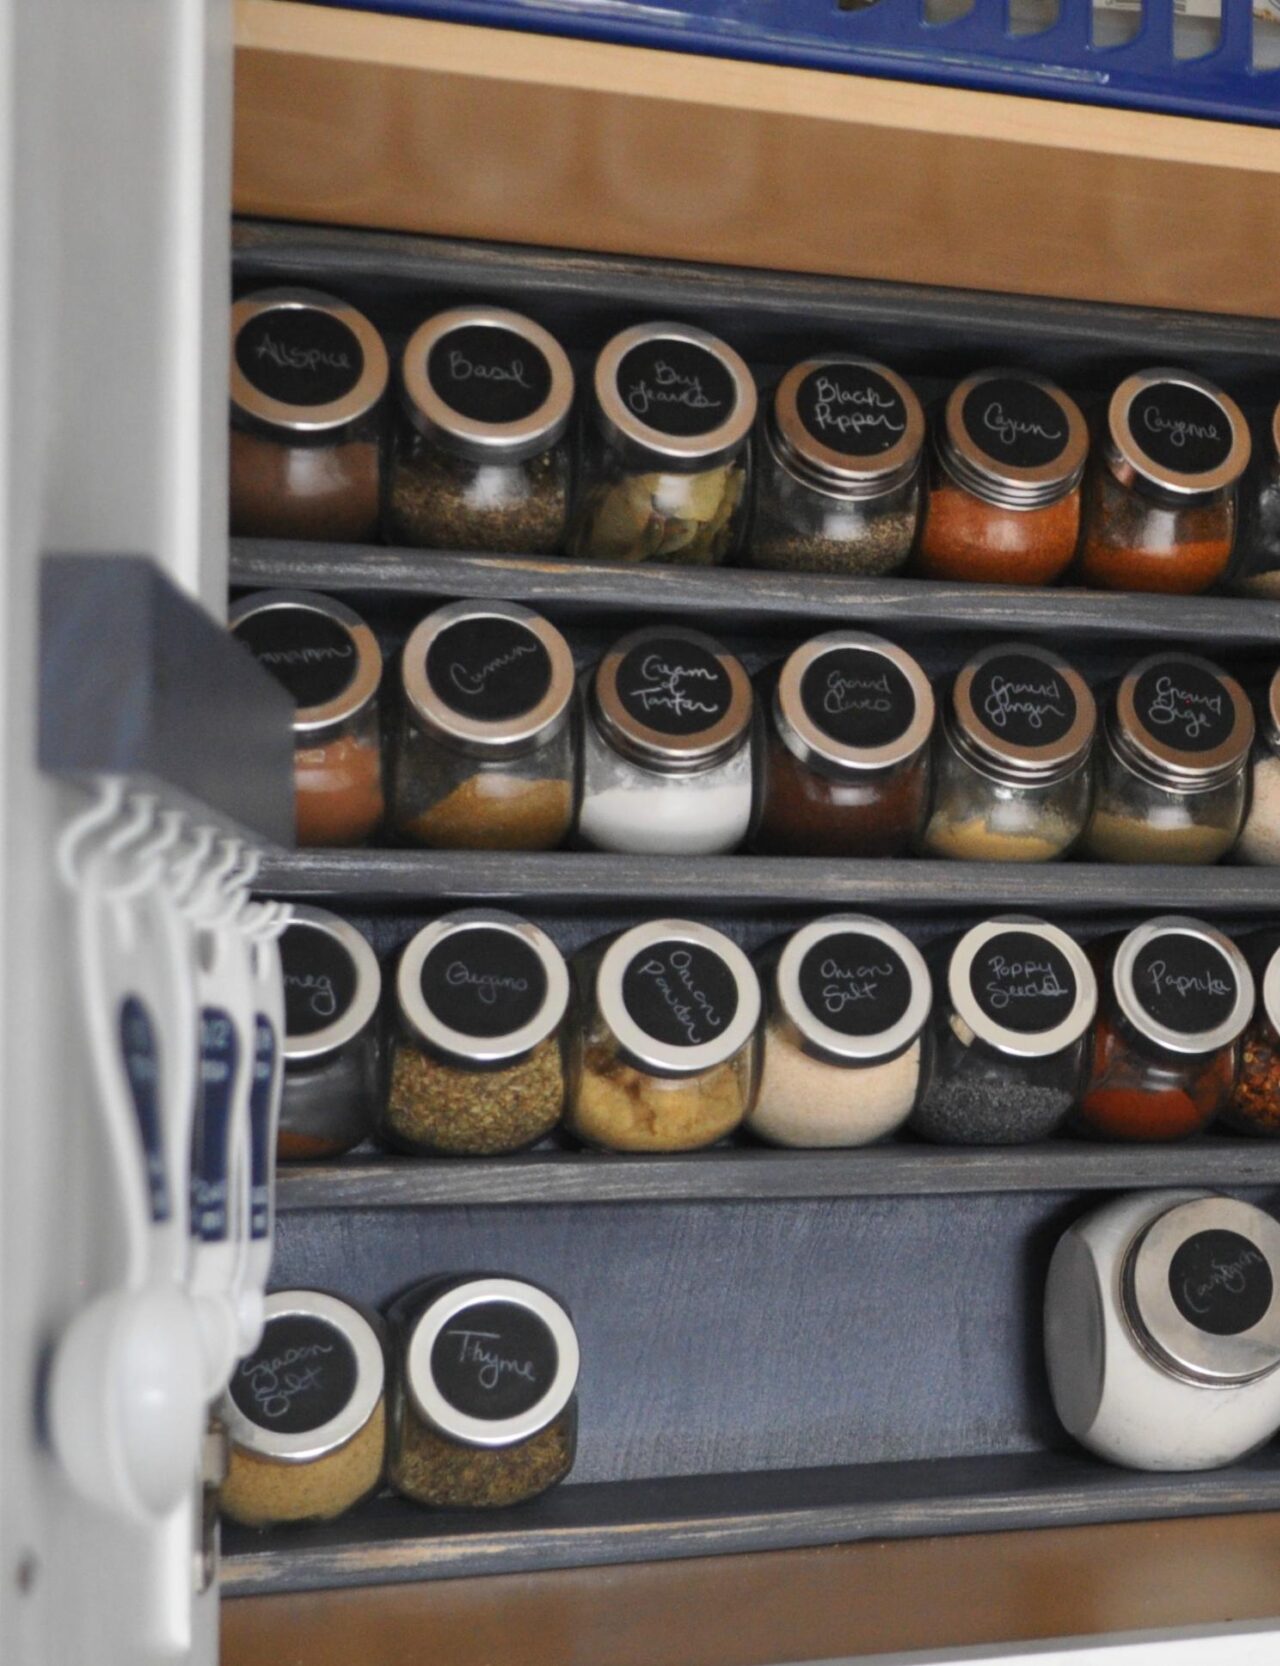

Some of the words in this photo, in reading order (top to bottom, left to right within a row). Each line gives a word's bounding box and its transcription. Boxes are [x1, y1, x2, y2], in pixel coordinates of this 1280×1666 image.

[255, 333, 352, 371] Allspice
[449, 350, 532, 389] Basil
[816, 377, 895, 407] Black
[815, 402, 905, 433] Pepper
[984, 402, 1061, 444] Cajun
[1144, 406, 1220, 446] Cayenne
[642, 654, 718, 681] Cream
[629, 686, 719, 716] Tartar
[991, 676, 1060, 703] Ground
[1156, 676, 1221, 715] Ground
[984, 694, 1065, 728] Ginger
[446, 961, 527, 1004] Oregano
[821, 959, 893, 979] Onion
[988, 955, 1058, 984] Poppy
[1147, 960, 1231, 997] Paprika
[638, 960, 702, 1043] Powder
[670, 951, 720, 1026] Onion
[823, 982, 878, 1013] Salt
[446, 1330, 536, 1388] Thyme
